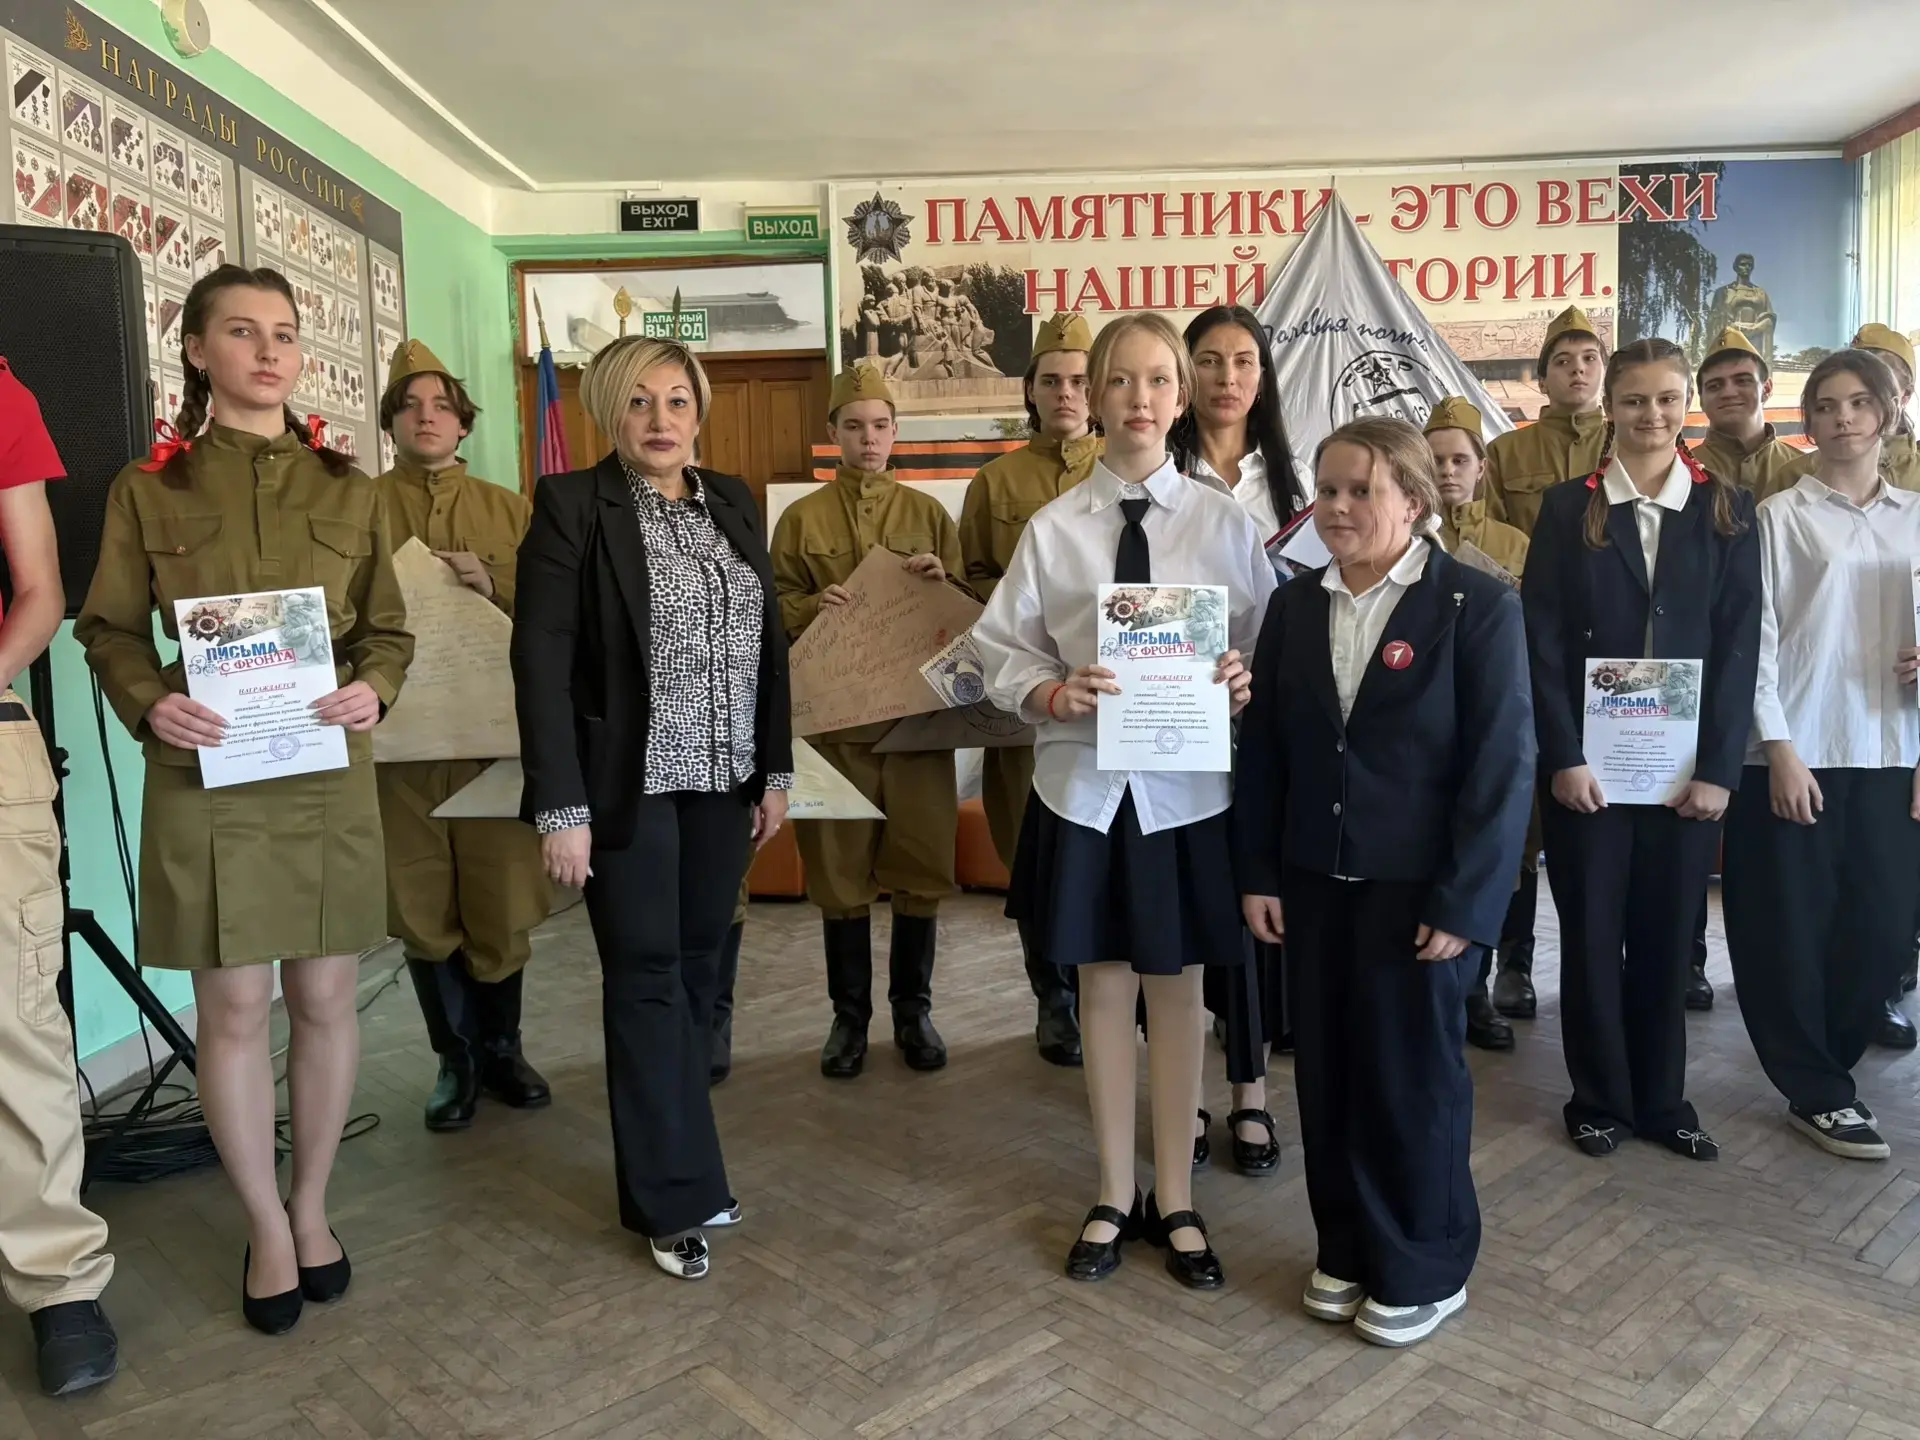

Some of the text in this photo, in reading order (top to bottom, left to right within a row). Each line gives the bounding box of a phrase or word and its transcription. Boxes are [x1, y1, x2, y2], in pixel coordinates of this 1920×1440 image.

[100, 37, 346, 213] НАГРАДЫ РОССИИ
[630, 204, 689, 218] ВЫХОД
[925, 188, 1333, 243] ПАМЯТНИКИ
[1390, 182, 1519, 231] ЭТО
[1536, 173, 1718, 227] ВЕХИ
[642, 217, 677, 228] EXIT
[753, 219, 814, 237] ВЫХОД
[1023, 245, 1269, 314] НАШЕЙ
[645, 312, 703, 324] ЗАПАНЫЙ
[1118, 631, 1182, 645] ПИСЬМА
[205, 641, 278, 661] ПИСЬМА
[947, 641, 965, 657] СССР
[1129, 643, 1194, 657] С ФРОНТА
[220, 651, 294, 672] С ФРОНТА
[1601, 696, 1657, 708] ПИСЬМА
[1610, 706, 1667, 716] С ФРОНТА
